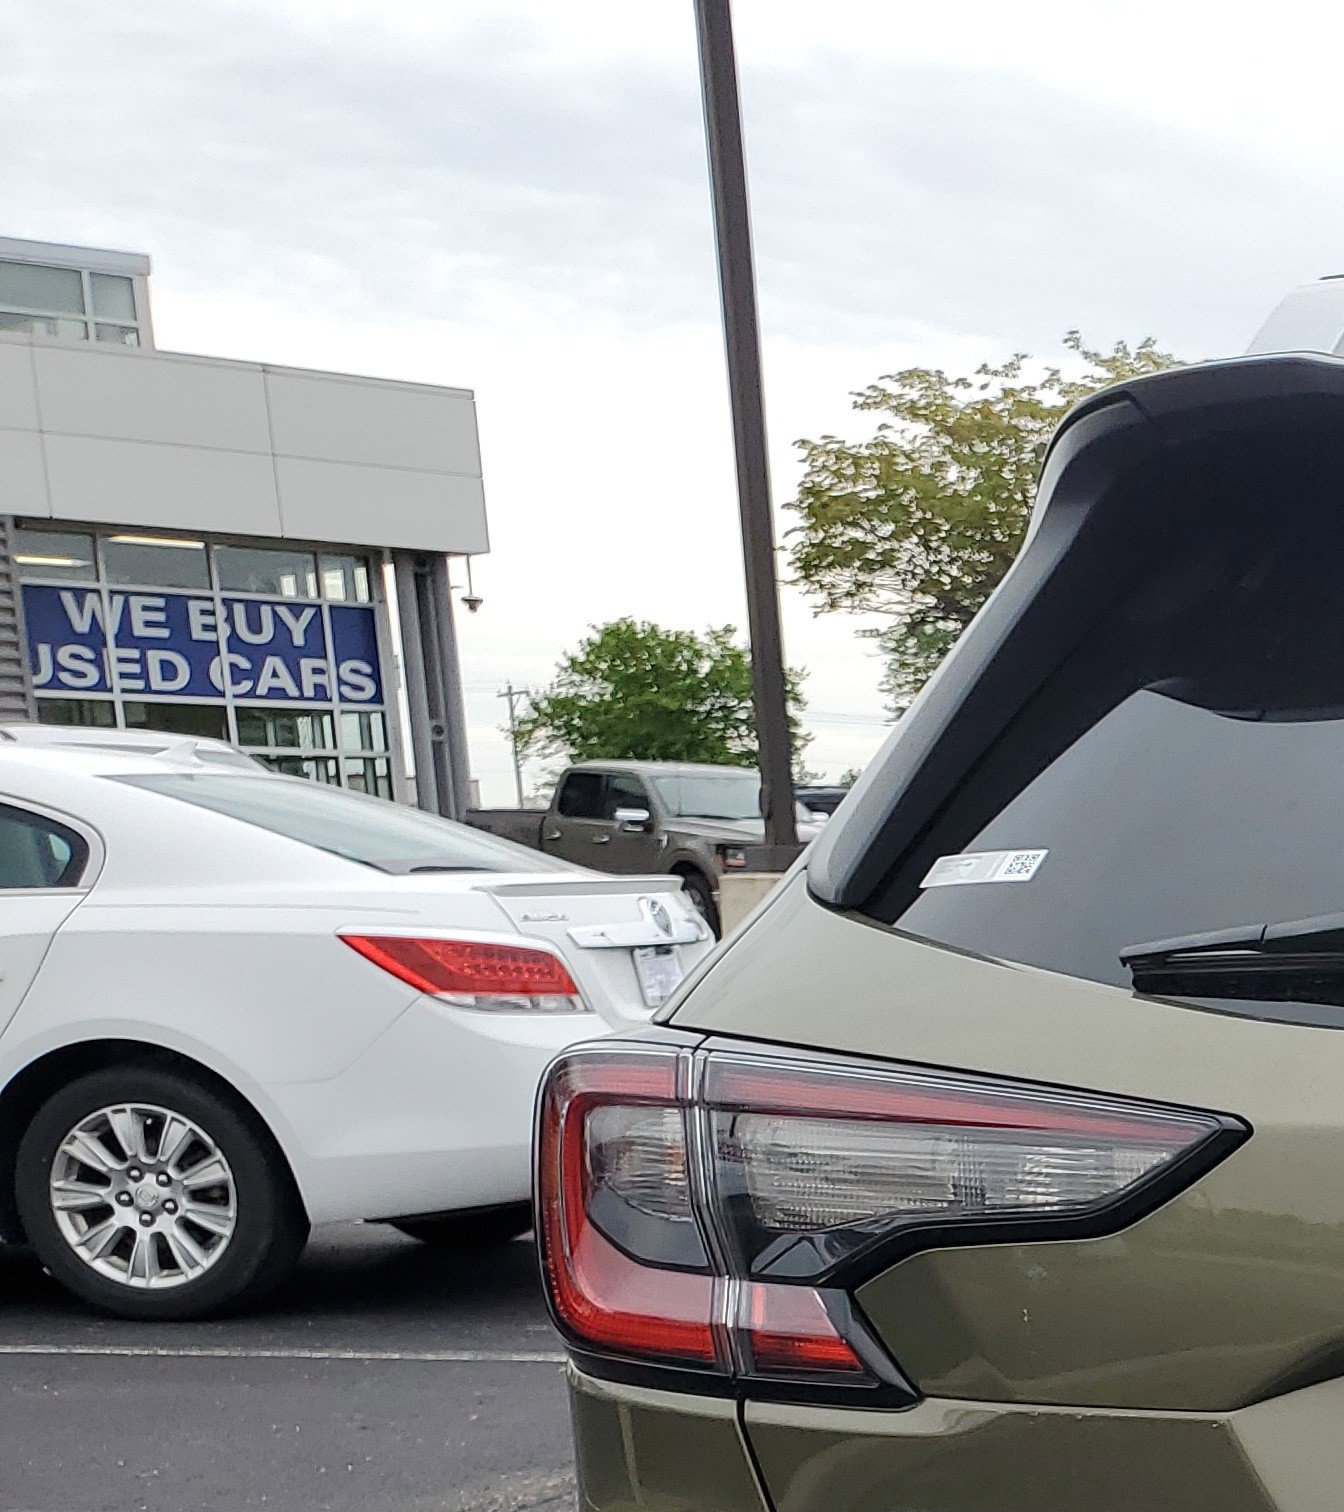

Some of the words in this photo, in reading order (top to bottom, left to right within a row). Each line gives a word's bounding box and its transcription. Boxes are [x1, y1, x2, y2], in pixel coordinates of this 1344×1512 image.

[59, 589, 171, 639] WE
[187, 599, 317, 647] BUY
[209, 653, 378, 701] CARS
